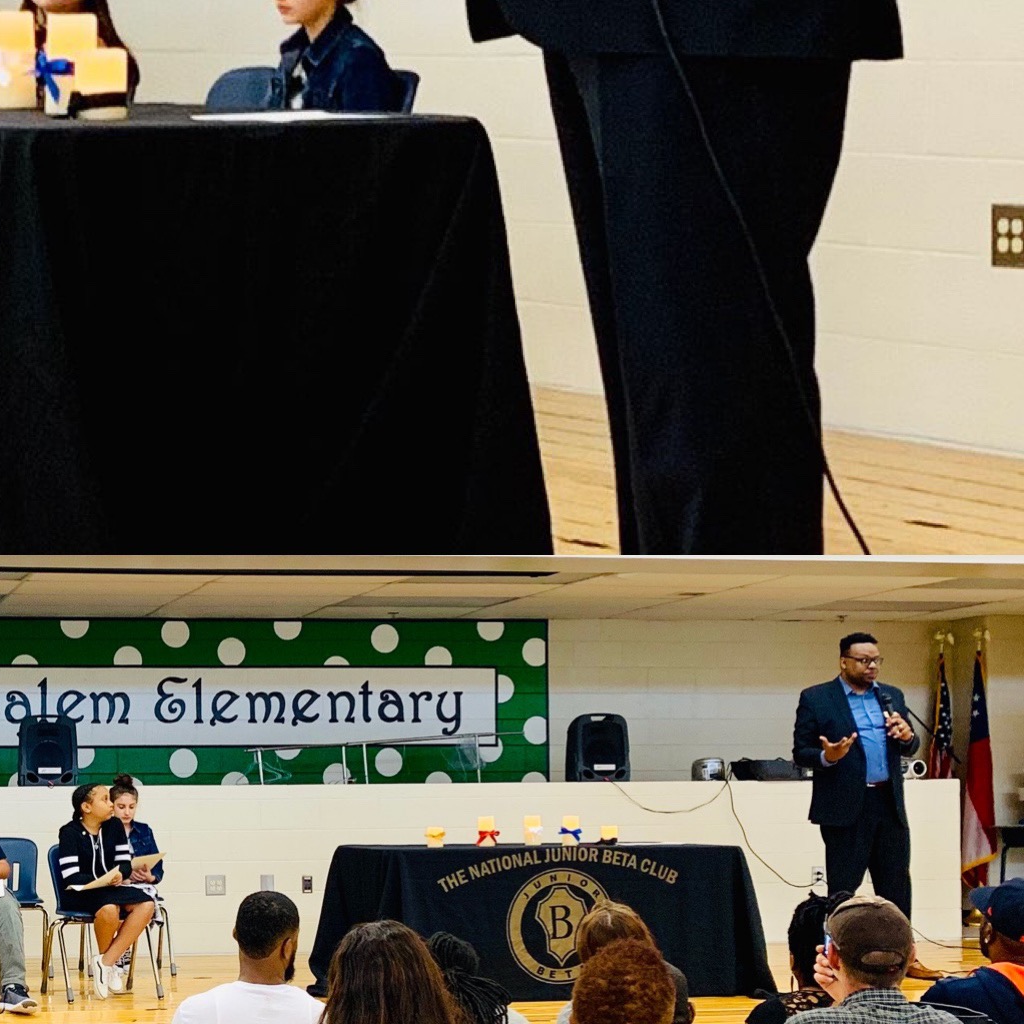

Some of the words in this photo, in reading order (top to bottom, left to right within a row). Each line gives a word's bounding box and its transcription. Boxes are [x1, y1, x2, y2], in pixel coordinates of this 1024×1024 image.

[154, 676, 463, 736] Elementary
[437, 869, 470, 893] THE
[467, 851, 542, 881] NATIONAL
[544, 847, 599, 864] JUNIOR
[601, 850, 643, 870] BETA
[640, 858, 679, 885] CLUB
[523, 874, 600, 899] JUNIOR
[548, 905, 574, 940] B
[536, 966, 582, 979] BET
